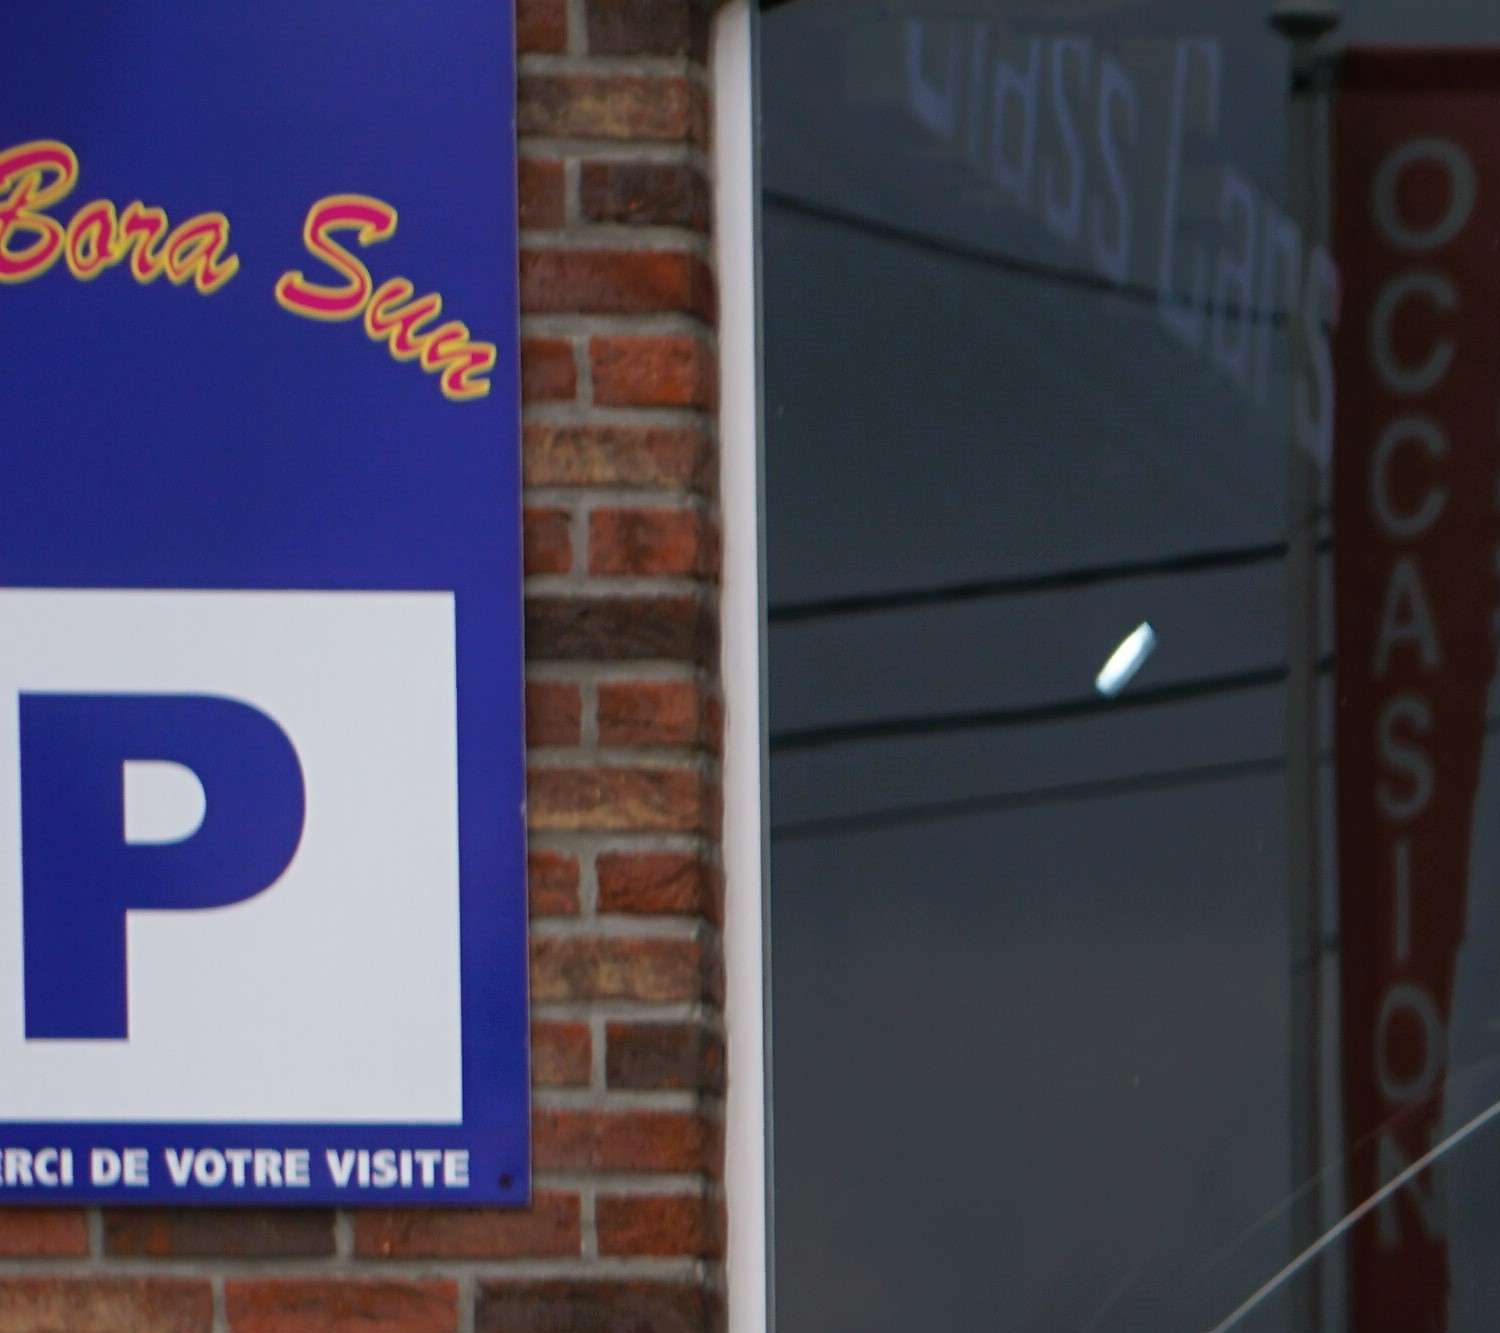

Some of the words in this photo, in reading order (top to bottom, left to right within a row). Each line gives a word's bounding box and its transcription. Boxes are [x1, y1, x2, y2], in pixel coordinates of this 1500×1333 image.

[0, 139, 240, 295] Bora
[274, 192, 497, 401] Sun
[1371, 138, 1476, 1247] OCCASION
[19, 691, 305, 1041] P
[0, 1148, 74, 1187] RCI
[90, 1148, 149, 1187] DE
[164, 1148, 310, 1188] VOTRE
[325, 1148, 469, 1188] VISITE
